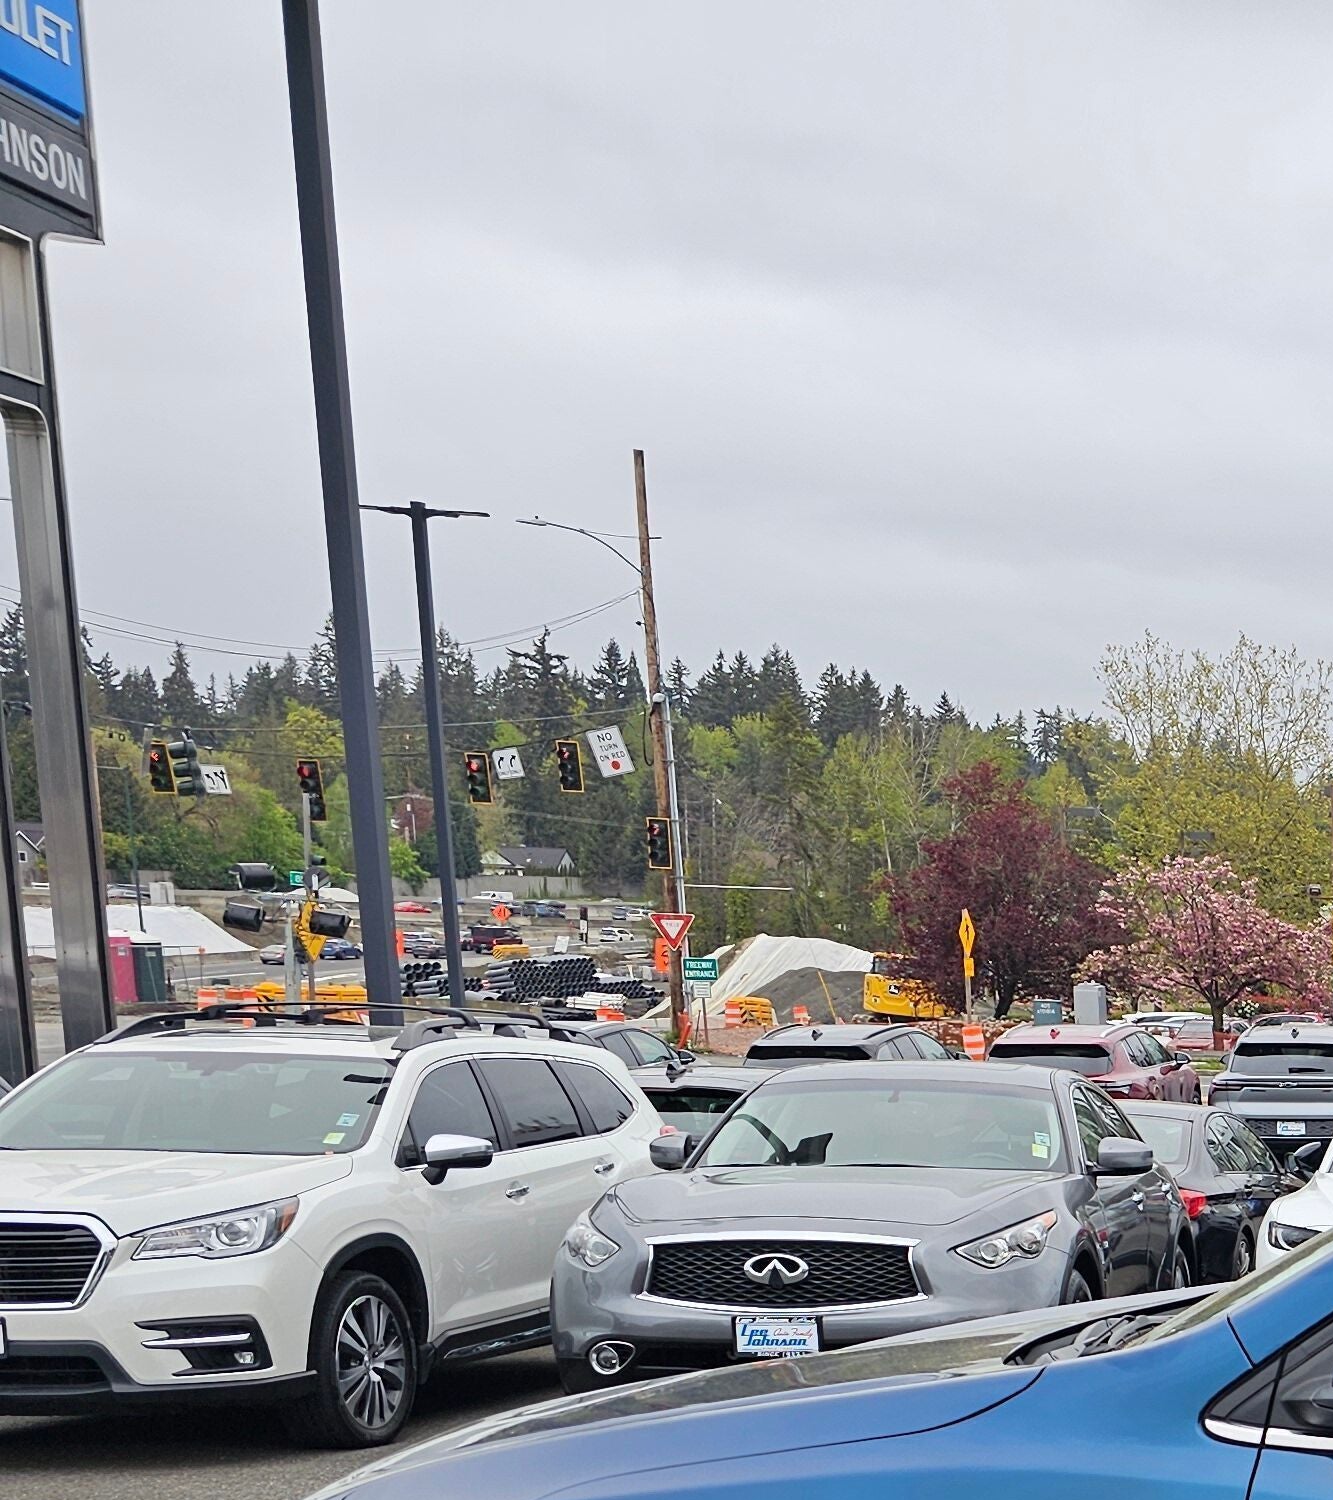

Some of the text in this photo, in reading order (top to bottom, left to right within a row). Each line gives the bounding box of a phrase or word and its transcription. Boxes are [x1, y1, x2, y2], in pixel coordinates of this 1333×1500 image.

[596, 732, 612, 743] NO
[600, 743, 618, 752] TURN
[600, 751, 626, 762] ON RED
[686, 961, 713, 969] FREEWAY
[684, 969, 717, 978] ENTRANCE
[741, 1323, 769, 1337] Lee
[742, 1331, 808, 1347] Johnson
